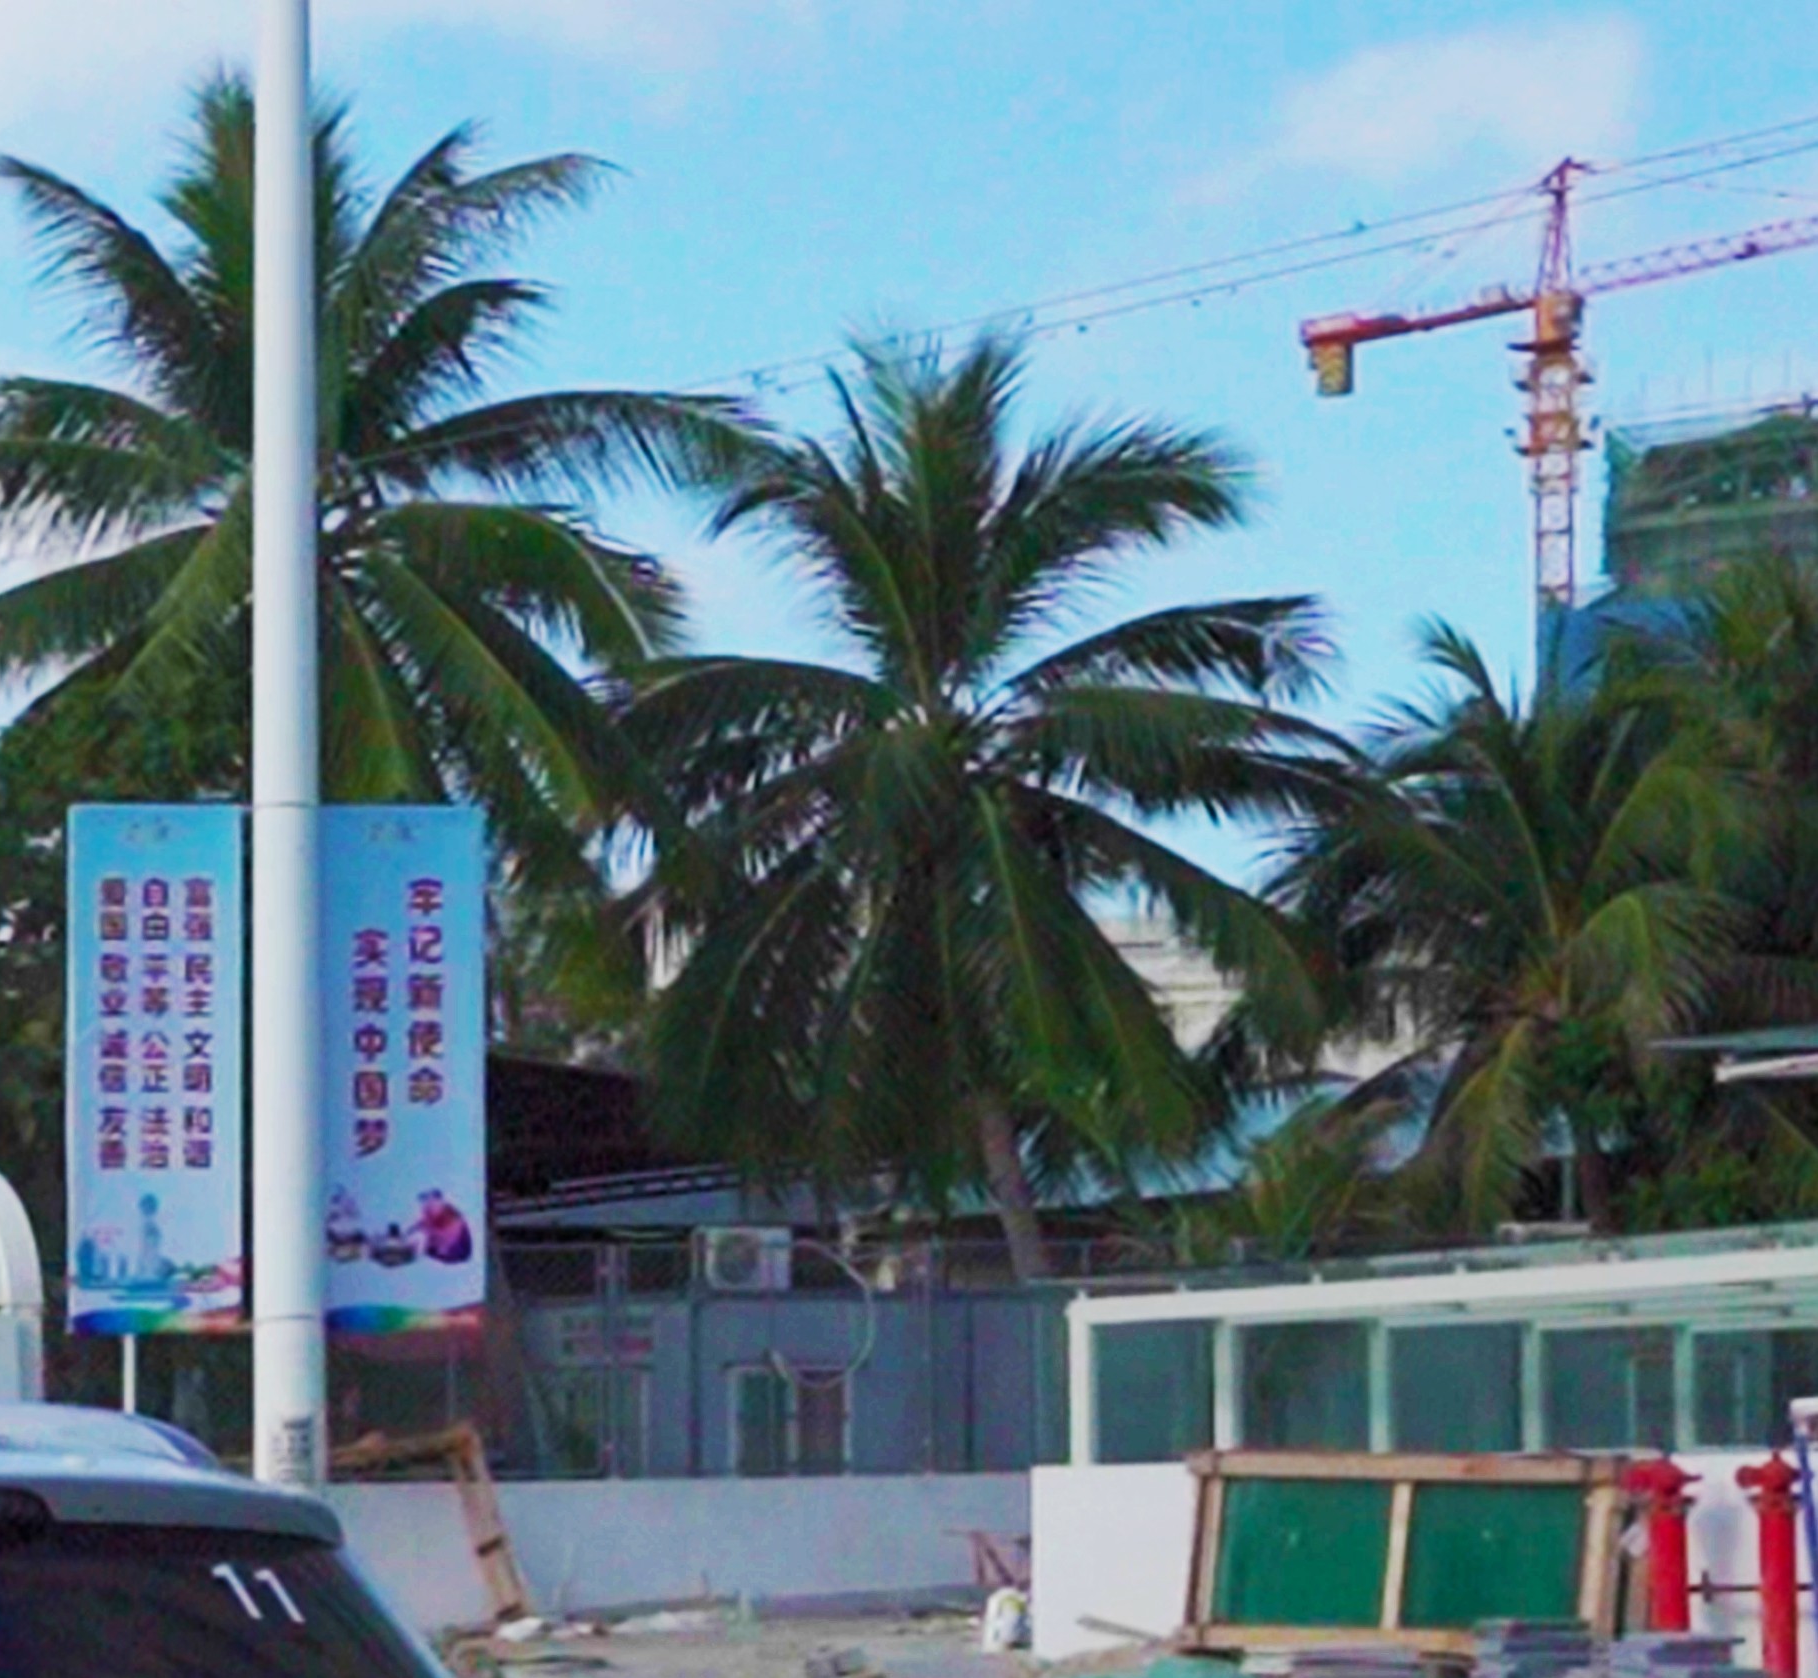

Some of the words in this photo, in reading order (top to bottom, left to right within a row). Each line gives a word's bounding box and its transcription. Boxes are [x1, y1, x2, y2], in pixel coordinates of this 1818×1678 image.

[353, 928, 390, 1157] 实现中国梦
[212, 1563, 305, 1624] 11
